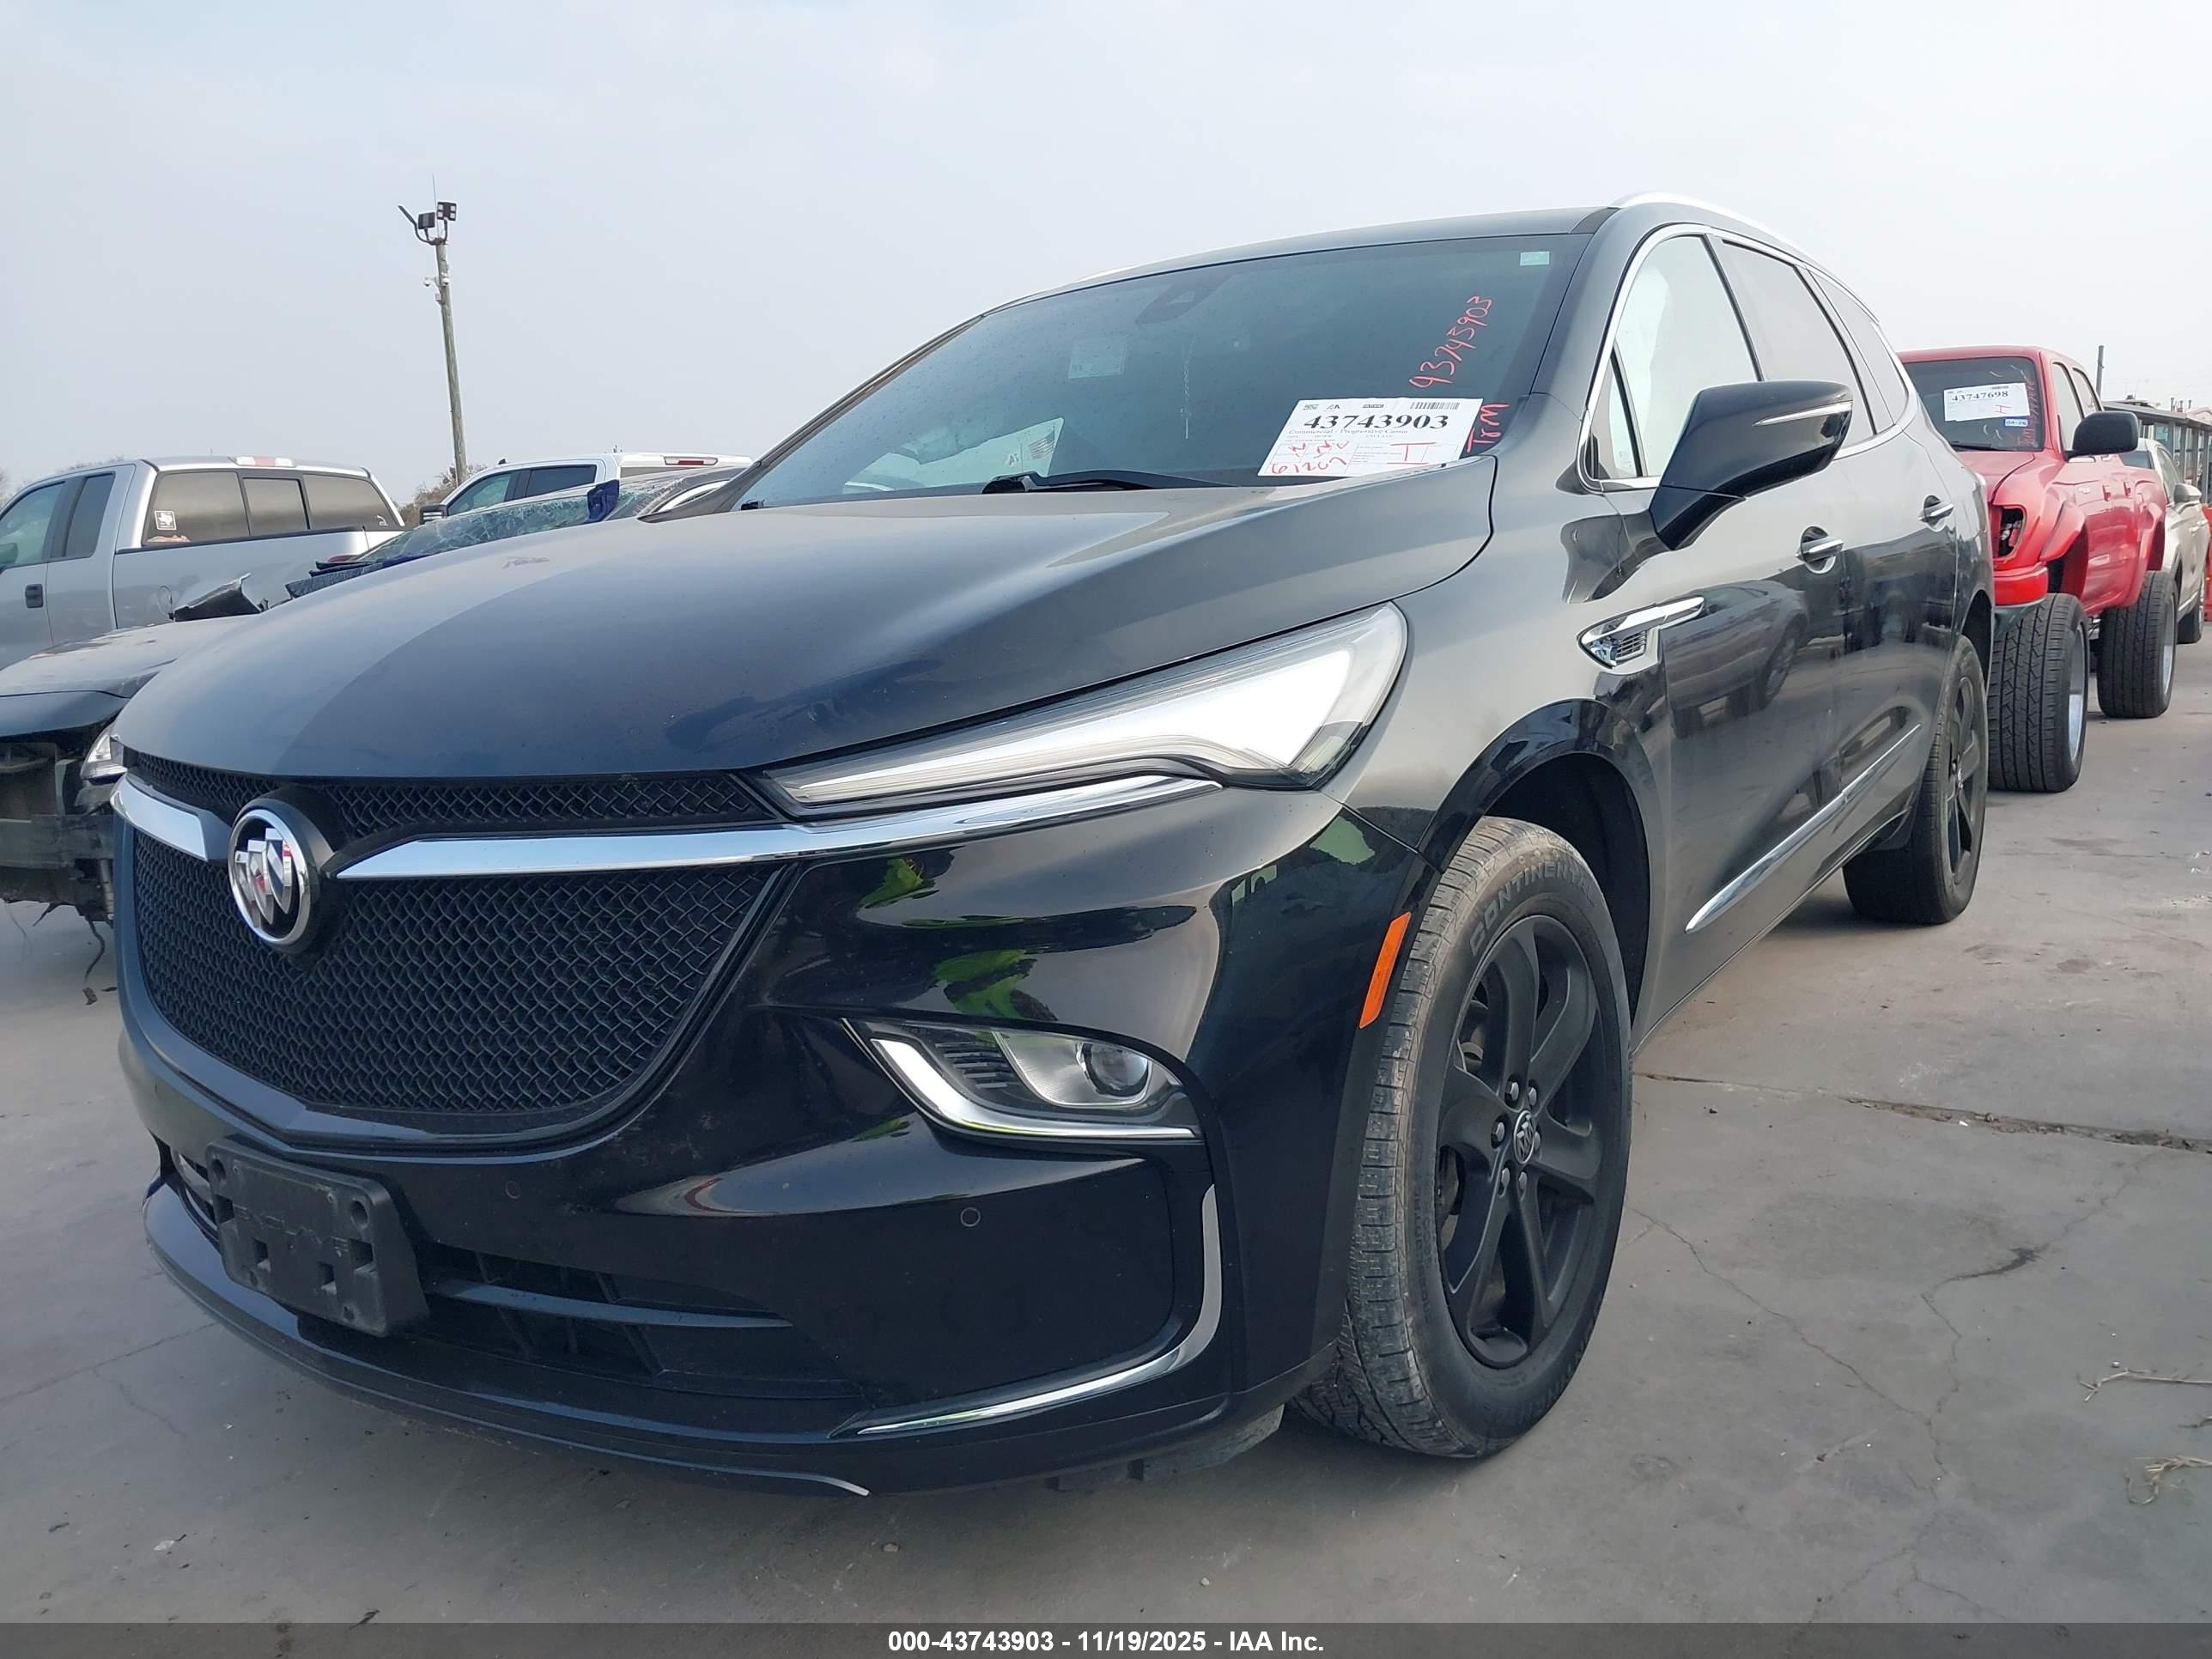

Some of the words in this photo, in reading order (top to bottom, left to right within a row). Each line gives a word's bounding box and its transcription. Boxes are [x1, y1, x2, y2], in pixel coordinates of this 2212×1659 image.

[1952, 391, 2009, 401] 43747698
[1304, 415, 1449, 429] 43743903
[1470, 860, 1595, 957] CONTINENTAL
